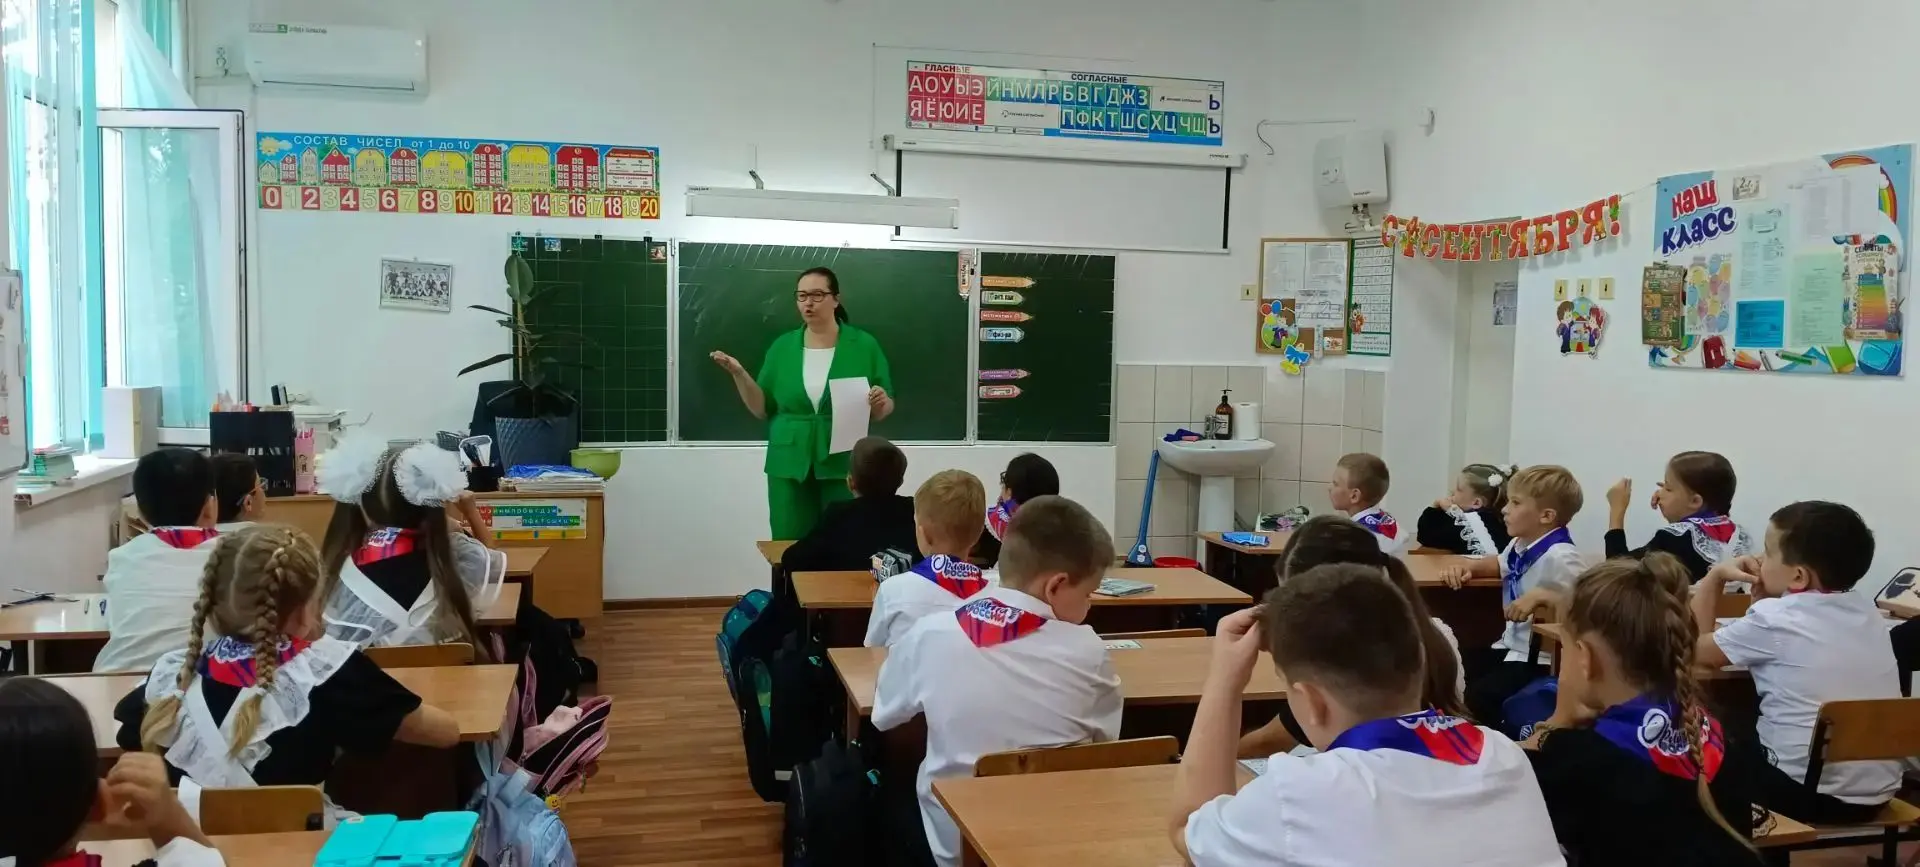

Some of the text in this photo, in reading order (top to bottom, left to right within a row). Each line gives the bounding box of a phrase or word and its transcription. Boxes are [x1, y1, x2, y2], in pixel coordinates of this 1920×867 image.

[924, 64, 970, 73] ГЛАСНЫЕ
[1071, 73, 1127, 83] СОГЛАСНЫЕ
[293, 135, 470, 150] СОСТАВ ЧИСЕЛ от 1 до 10
[265, 187, 657, 216] 0 1 2 3 4 5 6 7 8 9 10 11 12 13 14 15 16 17 18 19 20
[1420, 193, 1620, 261] СЕНТЯБРЯ!
